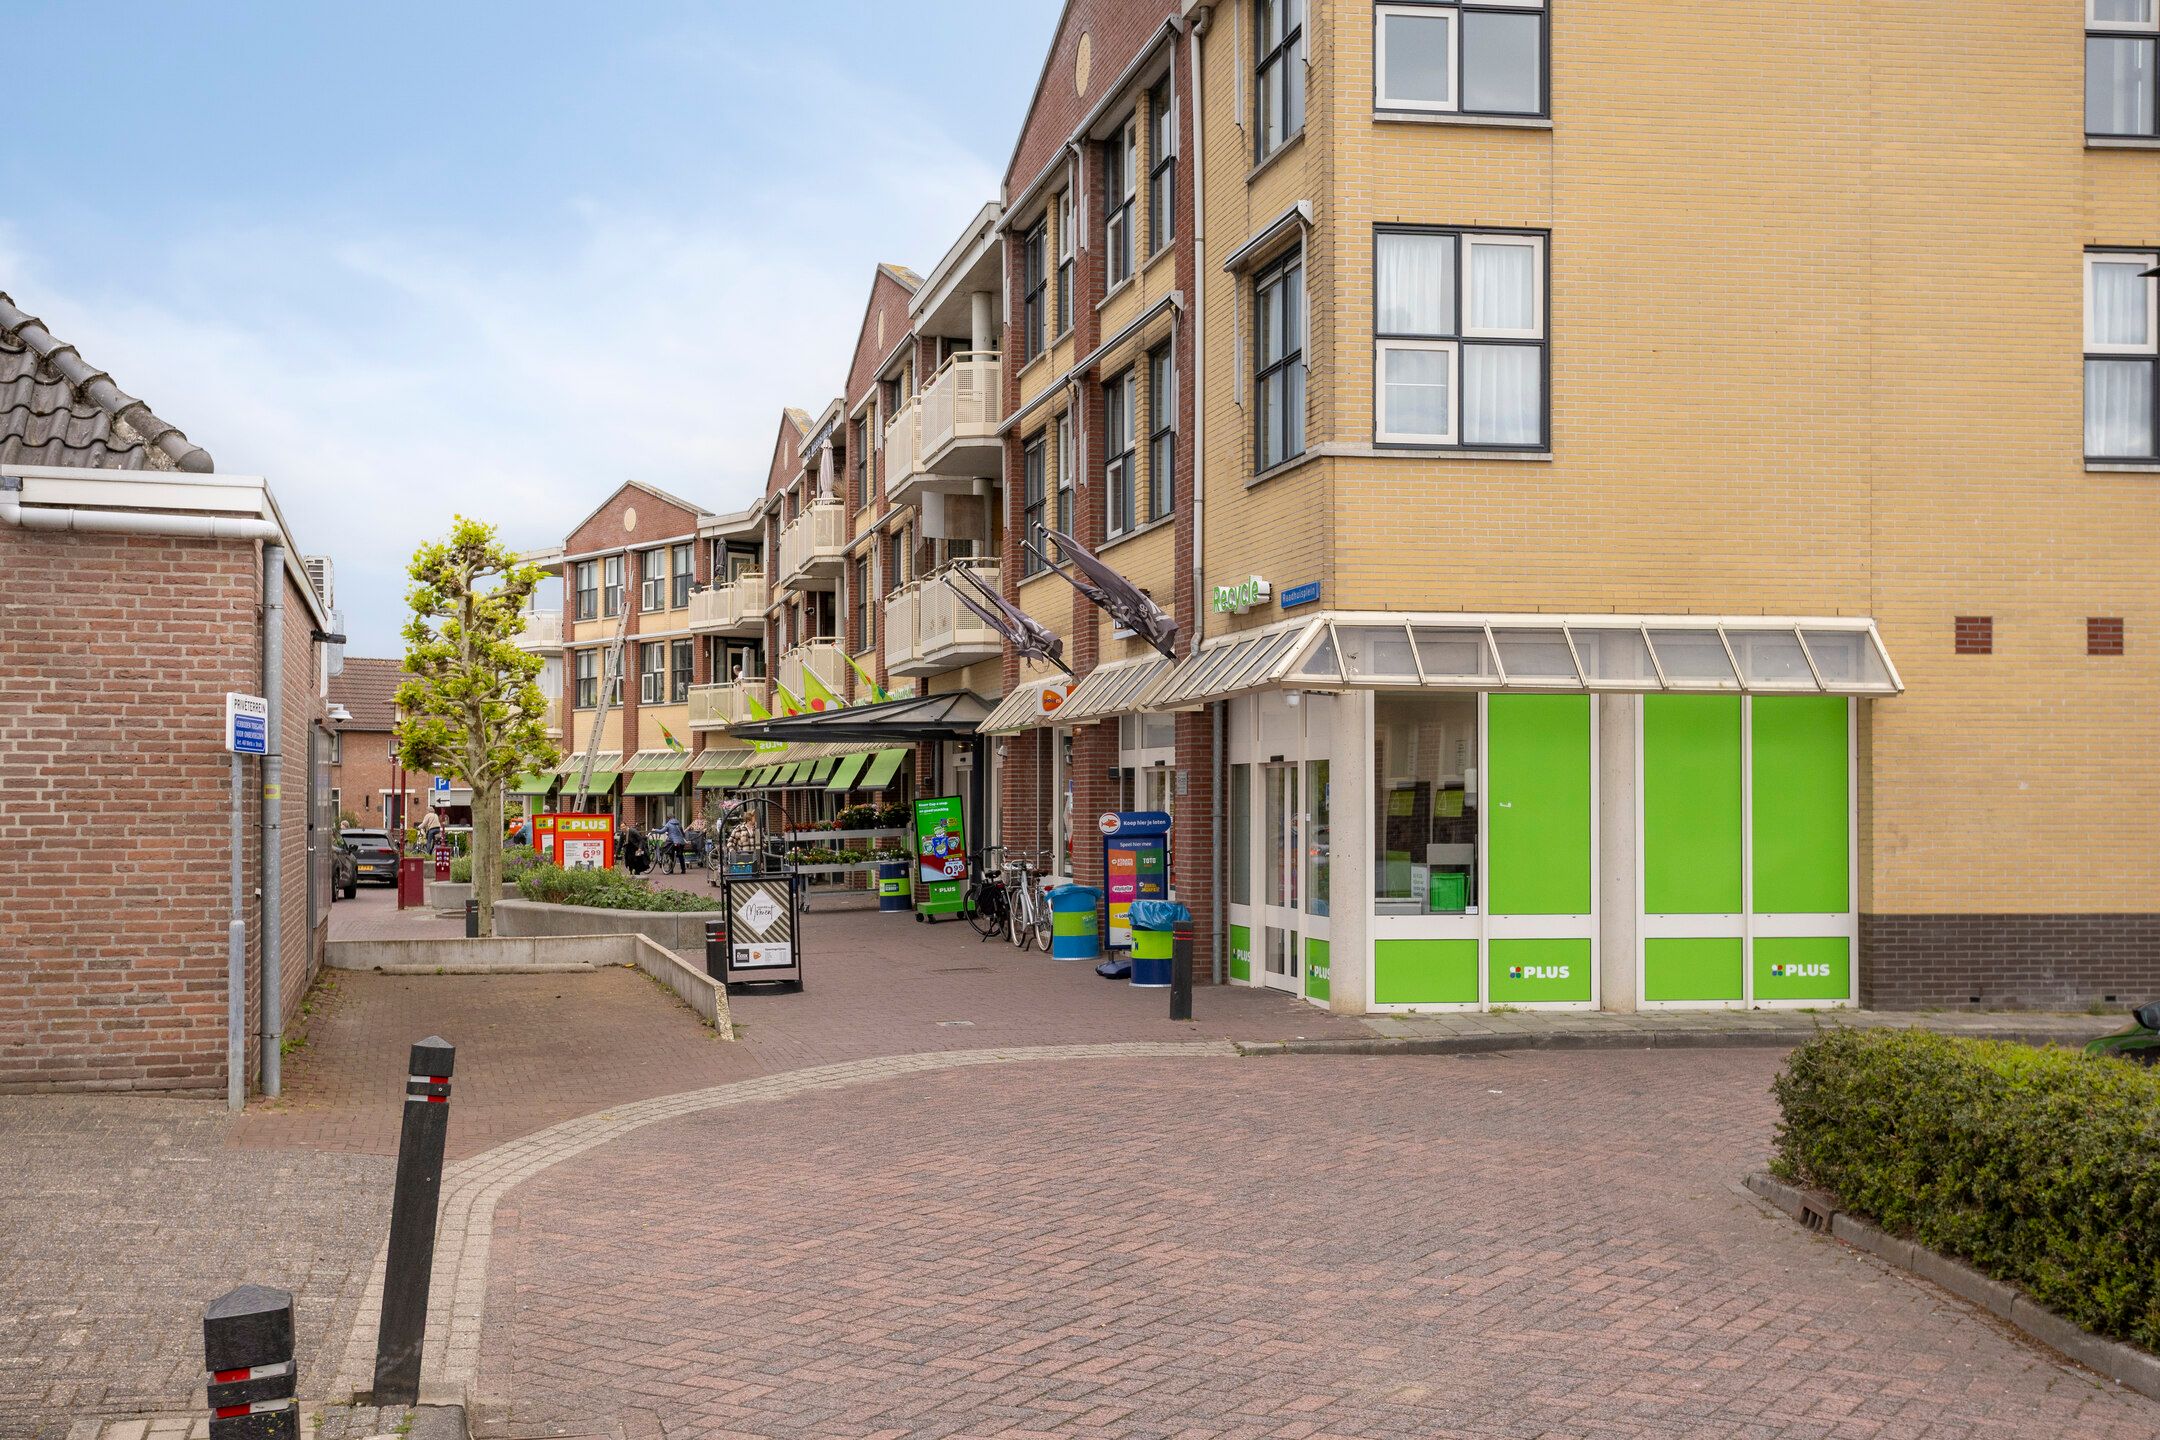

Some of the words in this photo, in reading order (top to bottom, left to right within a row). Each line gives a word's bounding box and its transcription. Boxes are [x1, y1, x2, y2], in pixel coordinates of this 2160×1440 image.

[1213, 575, 1259, 613] Recycle
[438, 778, 447, 790] P
[571, 820, 607, 830] PLUS
[1236, 949, 1250, 962] PLUS
[1524, 966, 1570, 979] PLUS
[1785, 963, 1830, 977] PLUS
